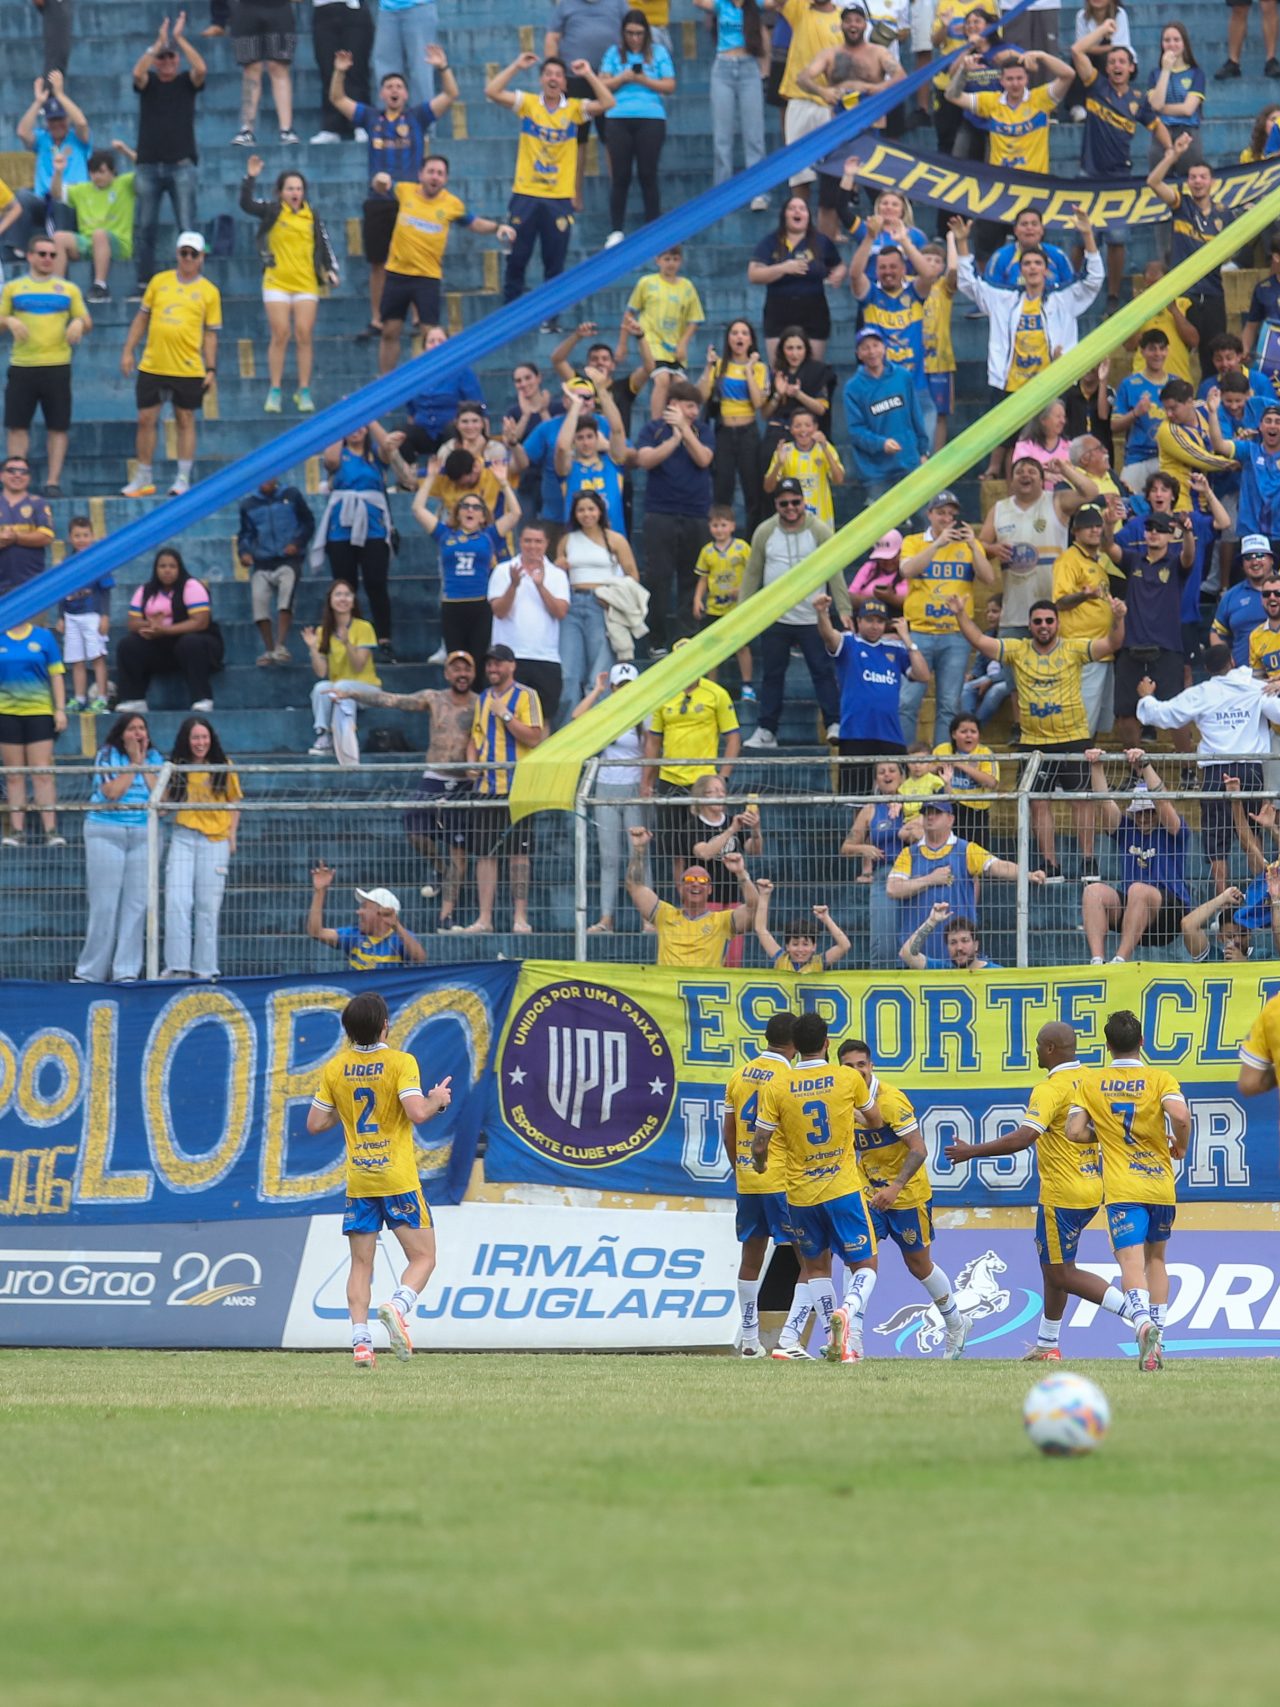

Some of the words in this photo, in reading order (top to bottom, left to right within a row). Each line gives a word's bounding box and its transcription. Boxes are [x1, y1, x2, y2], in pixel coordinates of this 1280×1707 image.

[456, 556, 474, 571] 21
[862, 669, 895, 685] Claro
[1029, 702, 1063, 718] Bob's
[513, 994, 553, 1046] UNIDOS
[549, 986, 582, 1002] POR
[584, 987, 619, 1008] UMA
[620, 1003, 664, 1057] PAIXÃO
[677, 979, 1107, 1073] ESPORTE
[343, 1062, 385, 1078] LIDER
[547, 1026, 628, 1129] UPP
[741, 1067, 775, 1082] LIDER
[1100, 1079, 1146, 1093] LIDER
[353, 1087, 379, 1134] 2
[510, 1104, 561, 1153] ESPORTE
[562, 1145, 607, 1160] CLUBE
[607, 1115, 660, 1156] PELOTAS
[740, 1089, 760, 1134] 4
[802, 1100, 832, 1146] 3
[1110, 1102, 1136, 1145] 7
[814, 1147, 845, 1160] dresch
[167, 1251, 264, 1307] 20
[471, 1235, 706, 1280] IRMÃOS
[222, 1295, 257, 1307] ANOS
[416, 1286, 736, 1320] JOUGLARD
